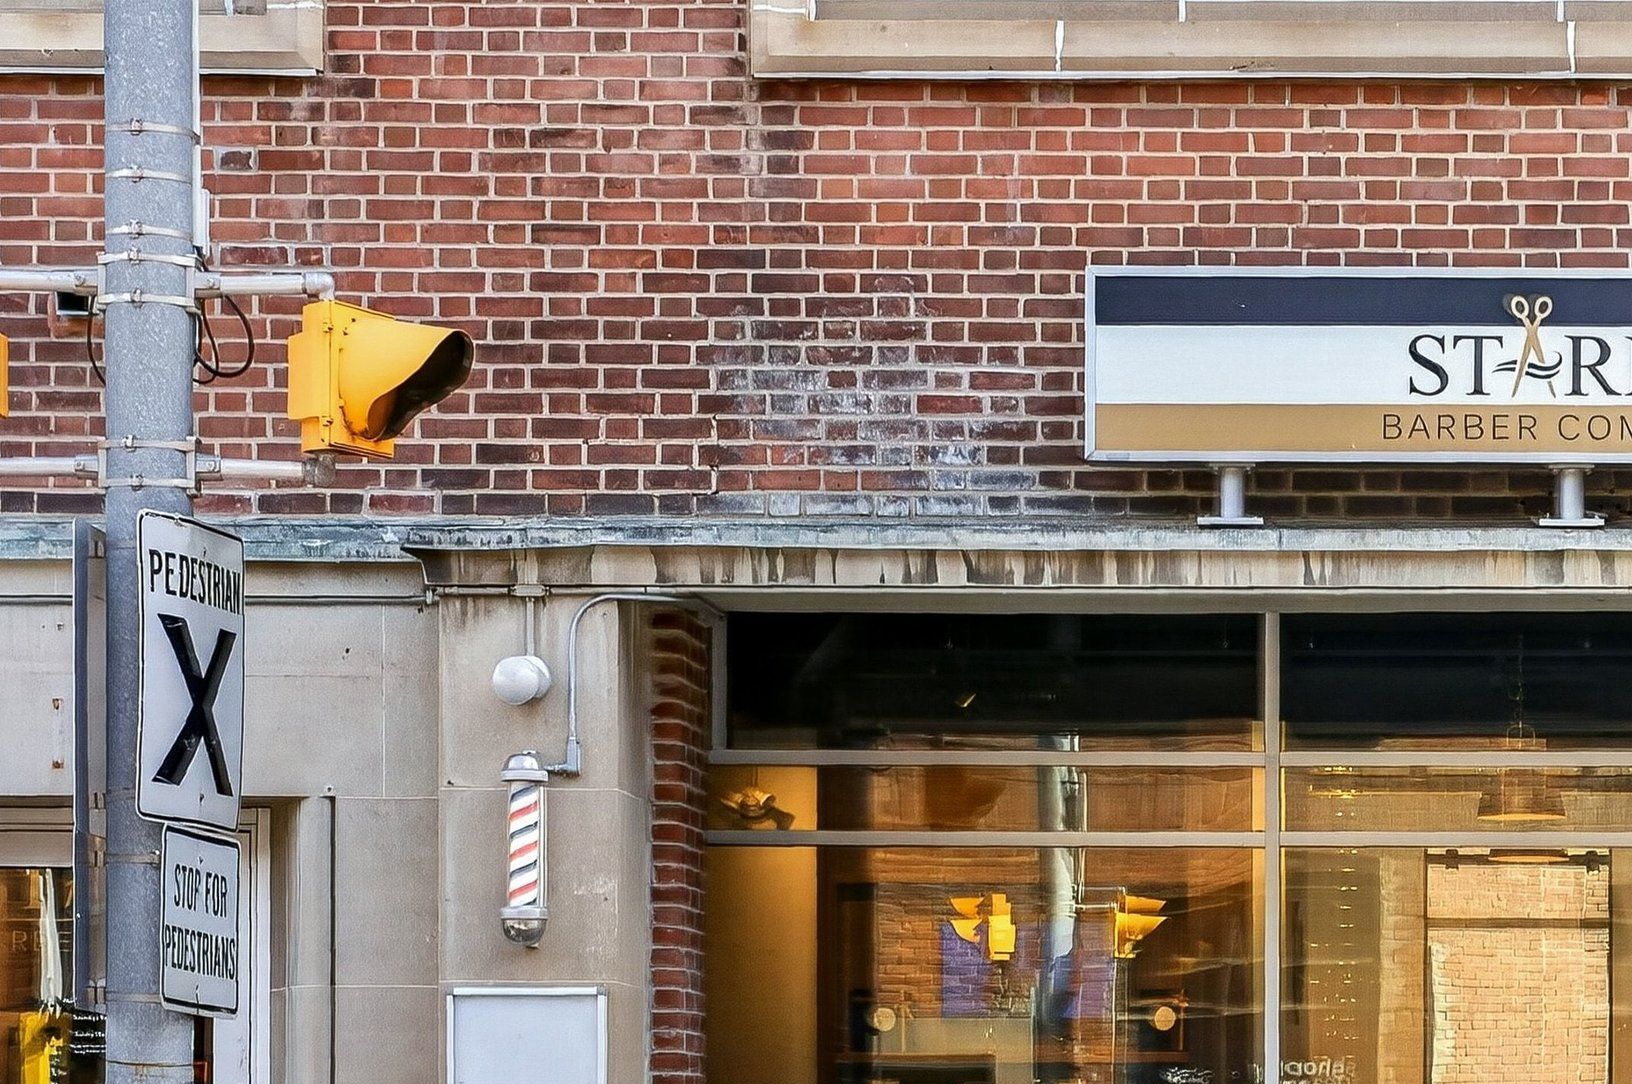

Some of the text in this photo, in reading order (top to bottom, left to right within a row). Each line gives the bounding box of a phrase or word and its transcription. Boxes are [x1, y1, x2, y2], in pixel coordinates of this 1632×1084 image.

[1382, 413, 1538, 441] BARBER
[148, 548, 241, 617] PEDESTRIAN
[173, 863, 229, 919] STOP FOR
[164, 923, 237, 981] PEDESTRIANS
